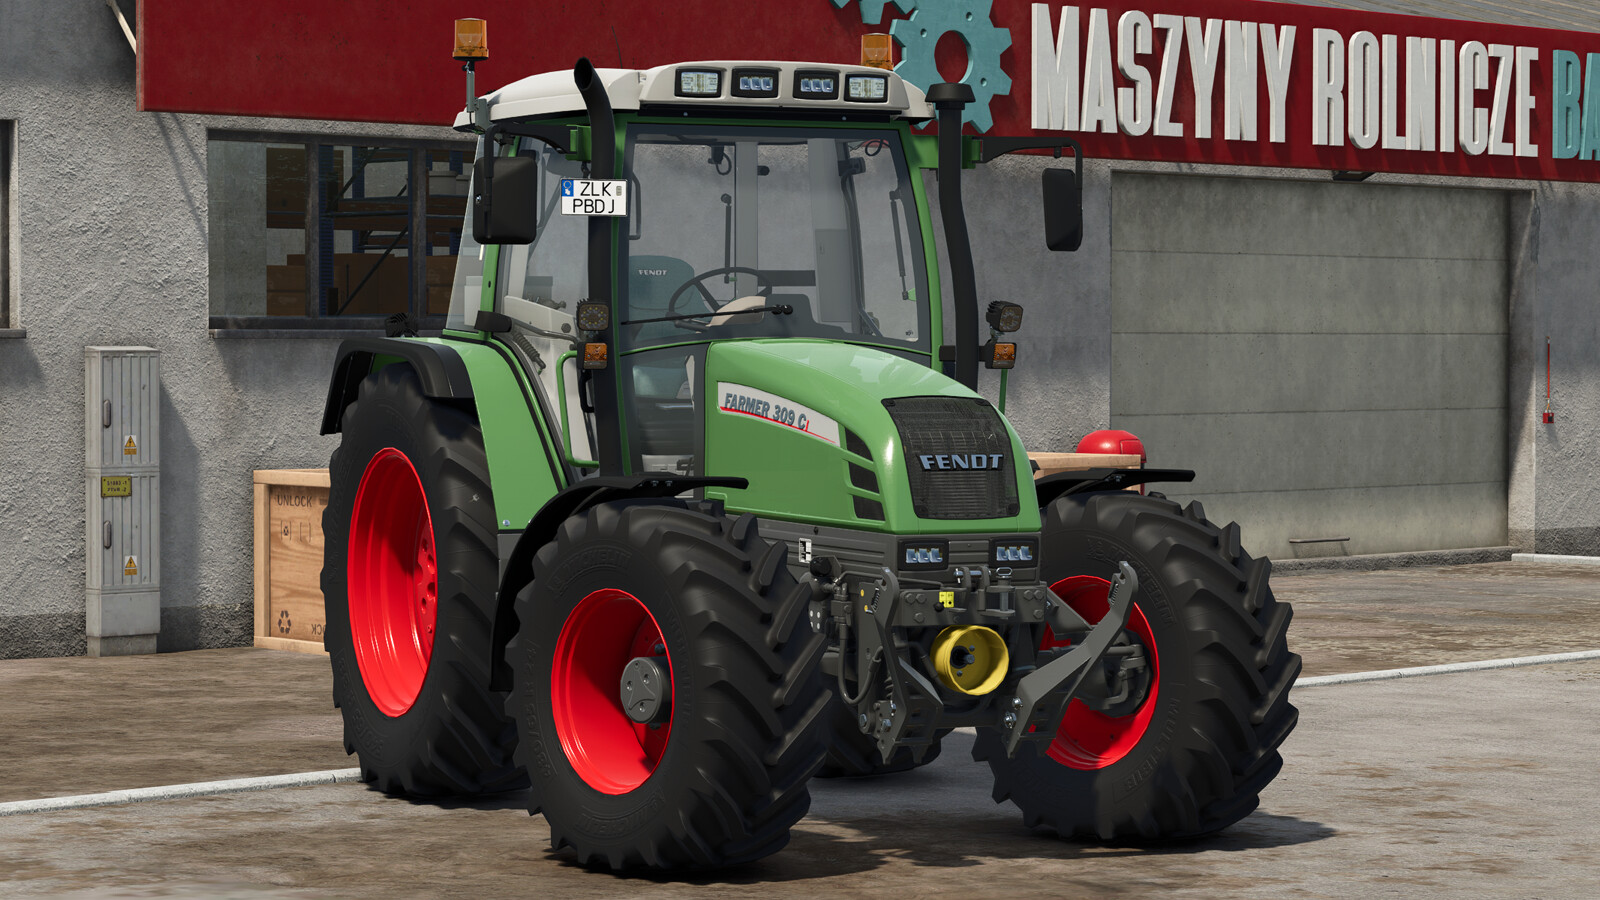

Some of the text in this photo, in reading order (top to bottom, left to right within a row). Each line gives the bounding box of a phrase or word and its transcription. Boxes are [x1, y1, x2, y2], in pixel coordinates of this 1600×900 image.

[1031, 3, 1297, 144] MASZYNY
[1312, 28, 1539, 158] ROLNICZE
[580, 181, 612, 197] ZLK
[724, 392, 770, 419] FARMER
[772, 404, 796, 427] 309
[919, 454, 1004, 470] FENDT
[277, 494, 313, 508] UNLOCK
